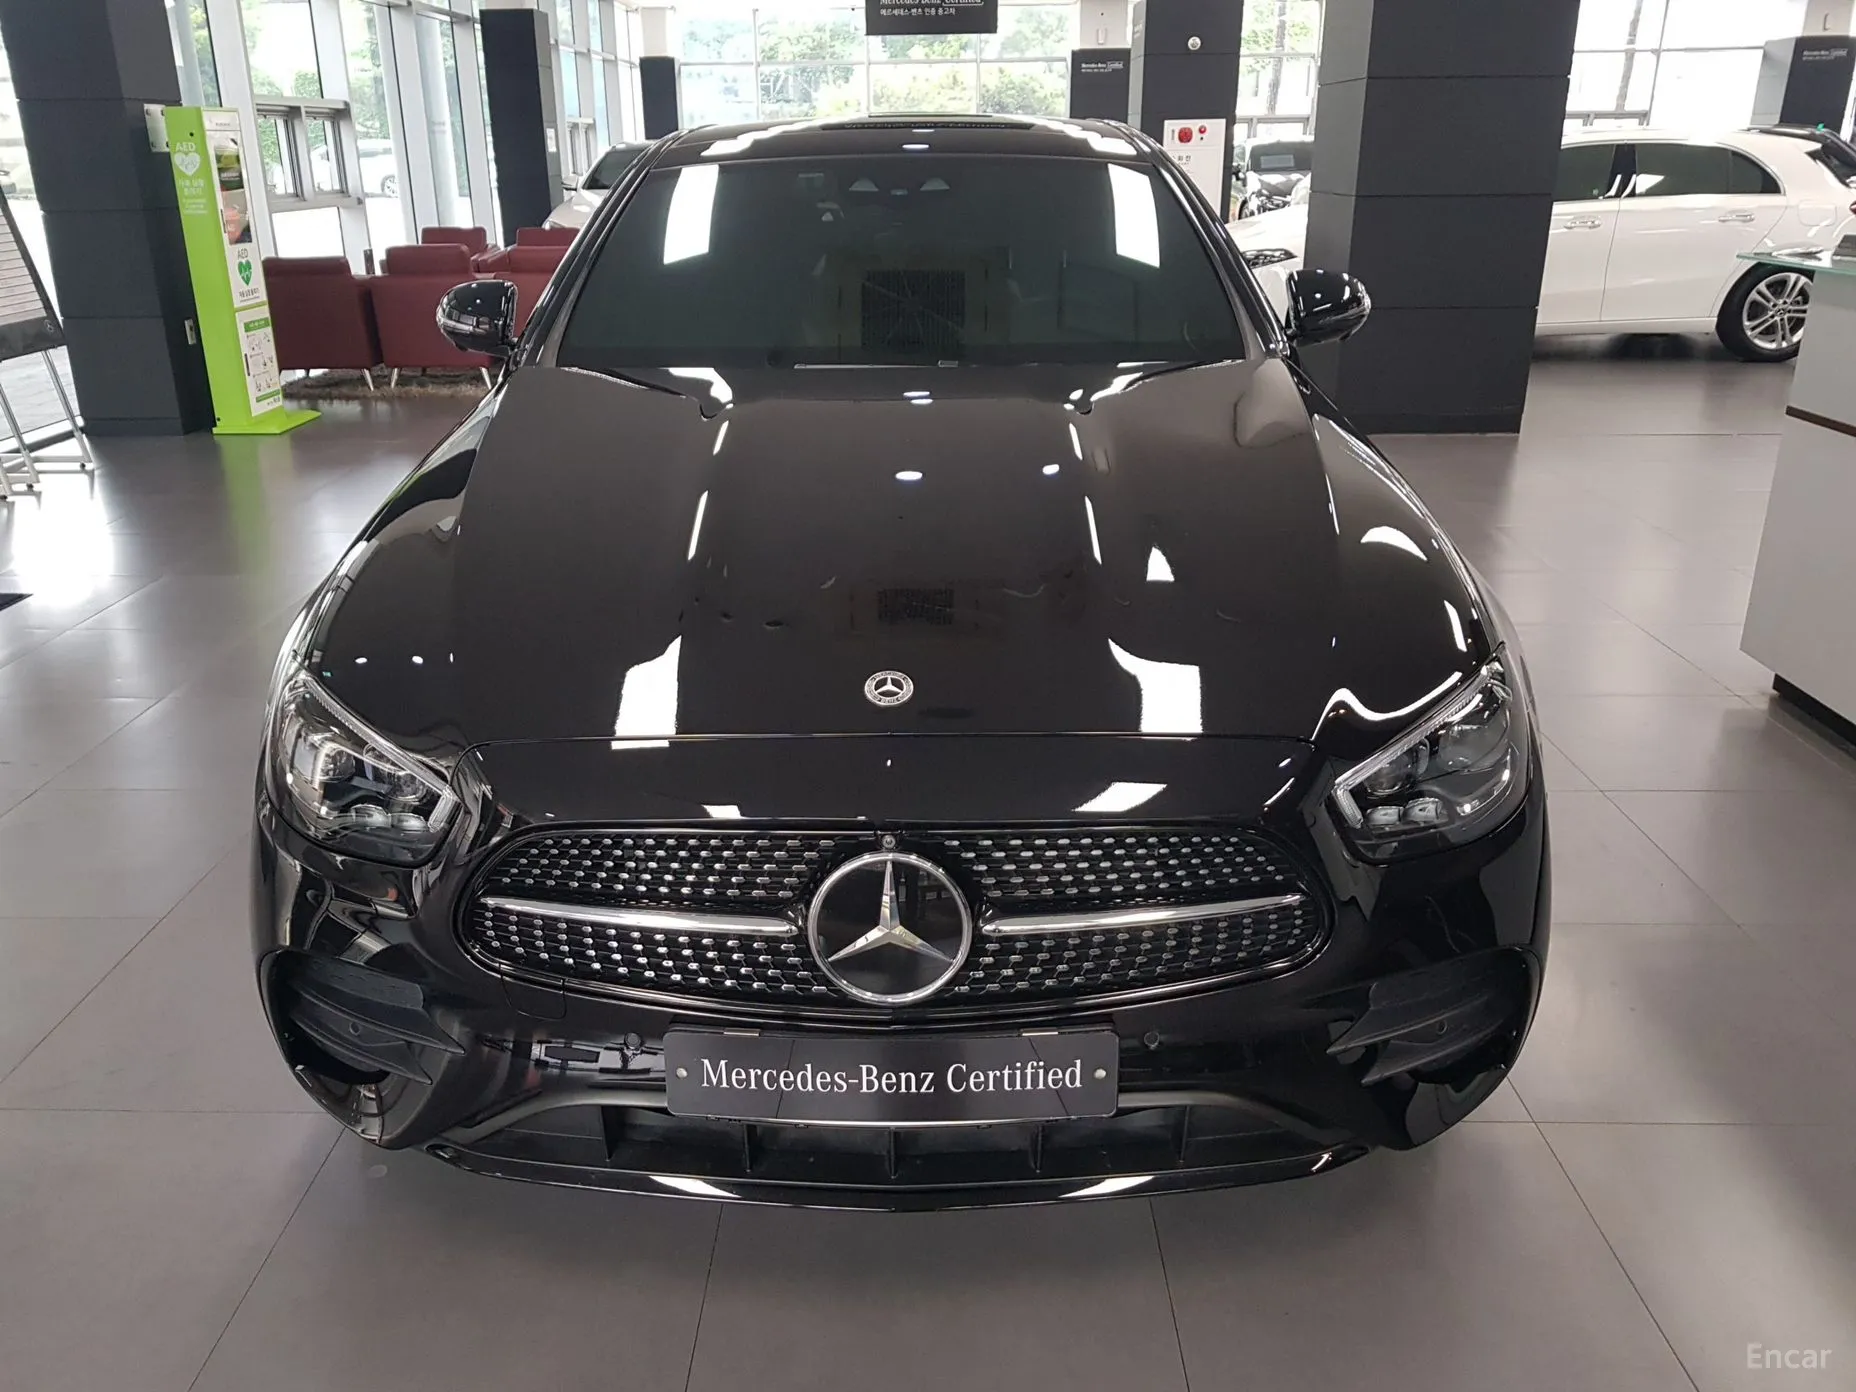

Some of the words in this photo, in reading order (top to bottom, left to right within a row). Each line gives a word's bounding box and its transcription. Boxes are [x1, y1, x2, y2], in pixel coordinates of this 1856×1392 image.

[176, 142, 196, 152] AED
[237, 248, 249, 260] AED
[701, 1058, 935, 1094] Mercedes-Benz
[946, 1059, 1083, 1093] Certified
